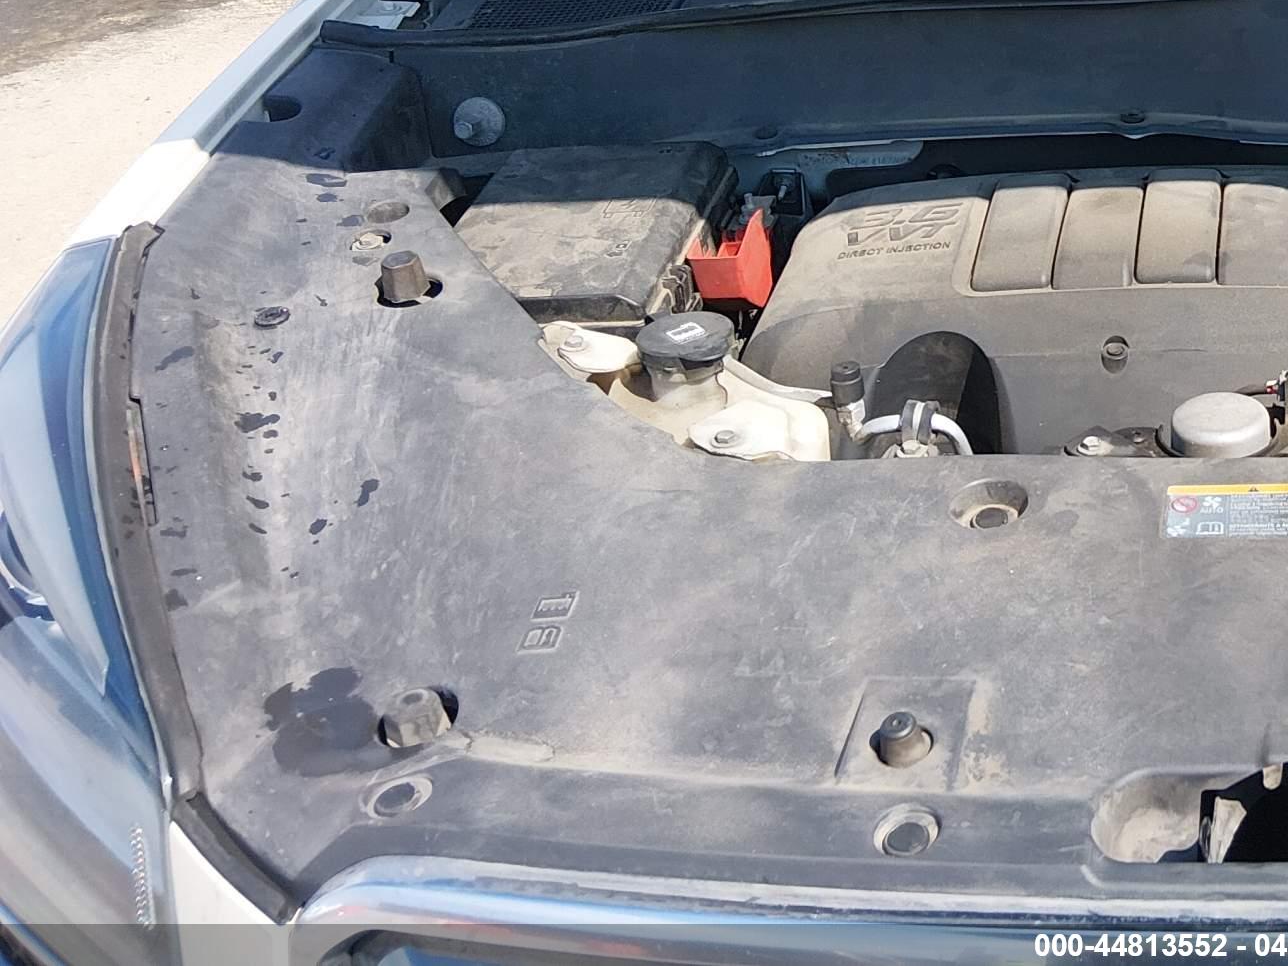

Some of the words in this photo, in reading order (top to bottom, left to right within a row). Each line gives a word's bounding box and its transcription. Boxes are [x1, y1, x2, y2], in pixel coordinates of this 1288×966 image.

[849, 202, 964, 231] 3.6
[847, 221, 957, 247] VVT
[837, 247, 883, 260] DIRECT
[886, 241, 952, 254] INJECTION
[1200, 506, 1224, 514] AUTO
